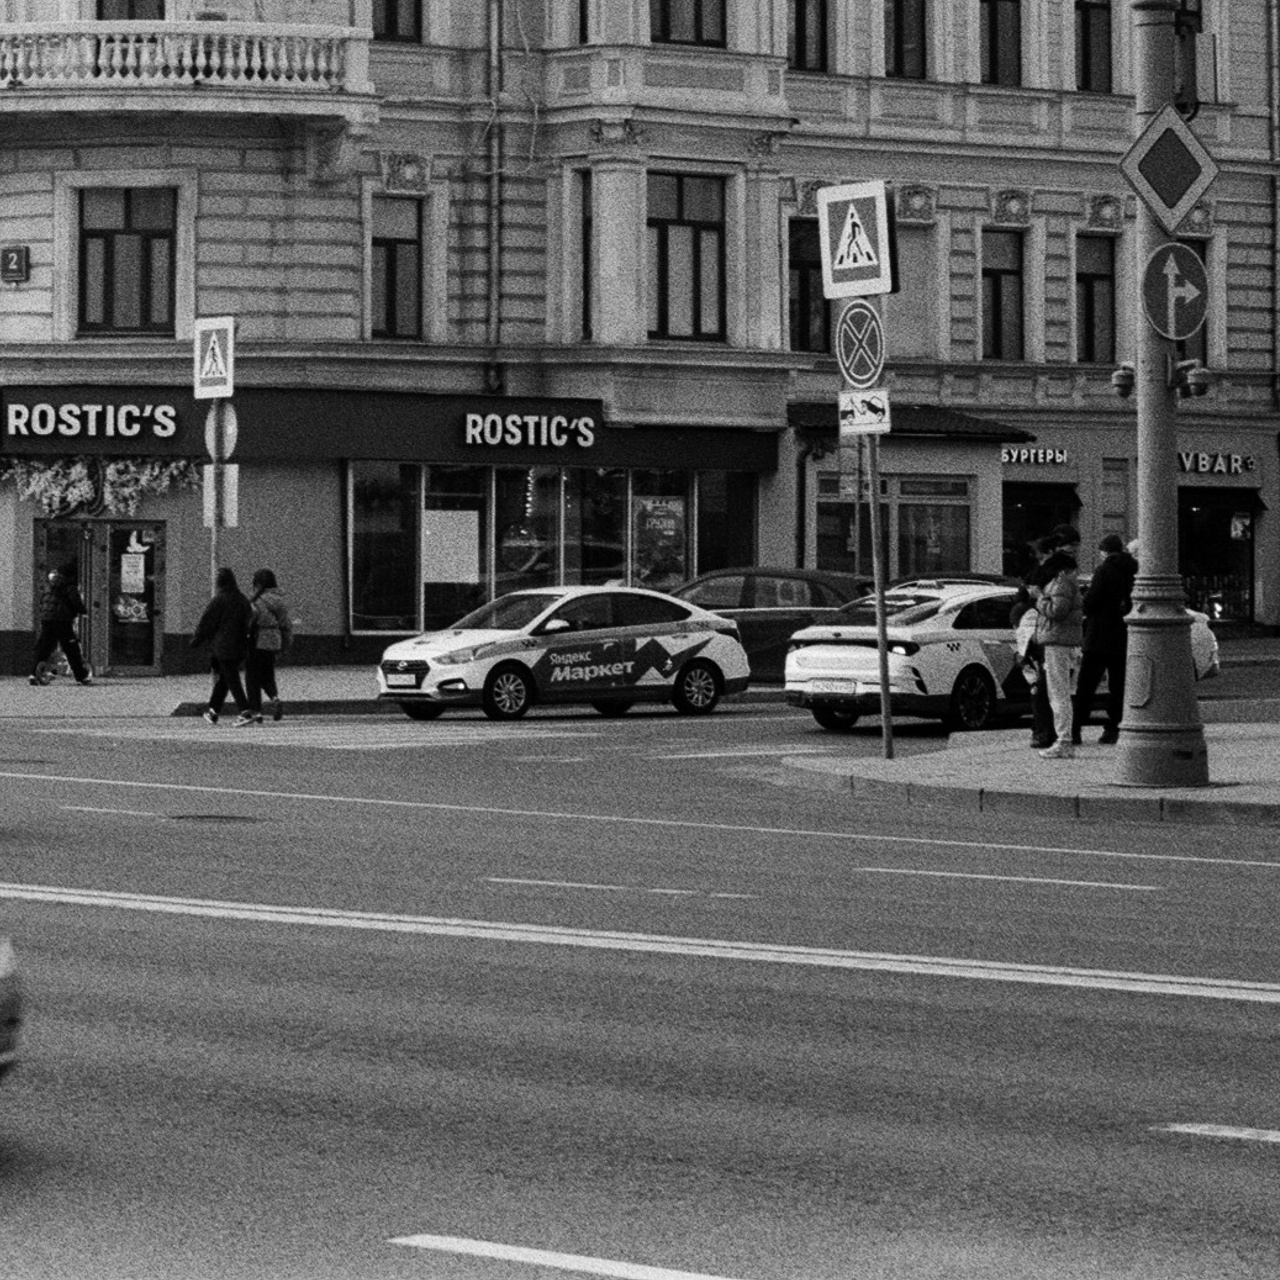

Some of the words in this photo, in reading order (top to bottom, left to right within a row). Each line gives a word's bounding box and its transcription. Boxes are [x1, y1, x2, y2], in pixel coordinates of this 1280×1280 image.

[8, 252, 18, 269] 2
[7, 403, 177, 438] ROSTIC'S
[466, 413, 595, 447] ROSTIC'S
[1001, 449, 1067, 463] БУРГЕРЫ
[550, 651, 592, 665] Яндекс
[550, 661, 635, 682] Маркет
